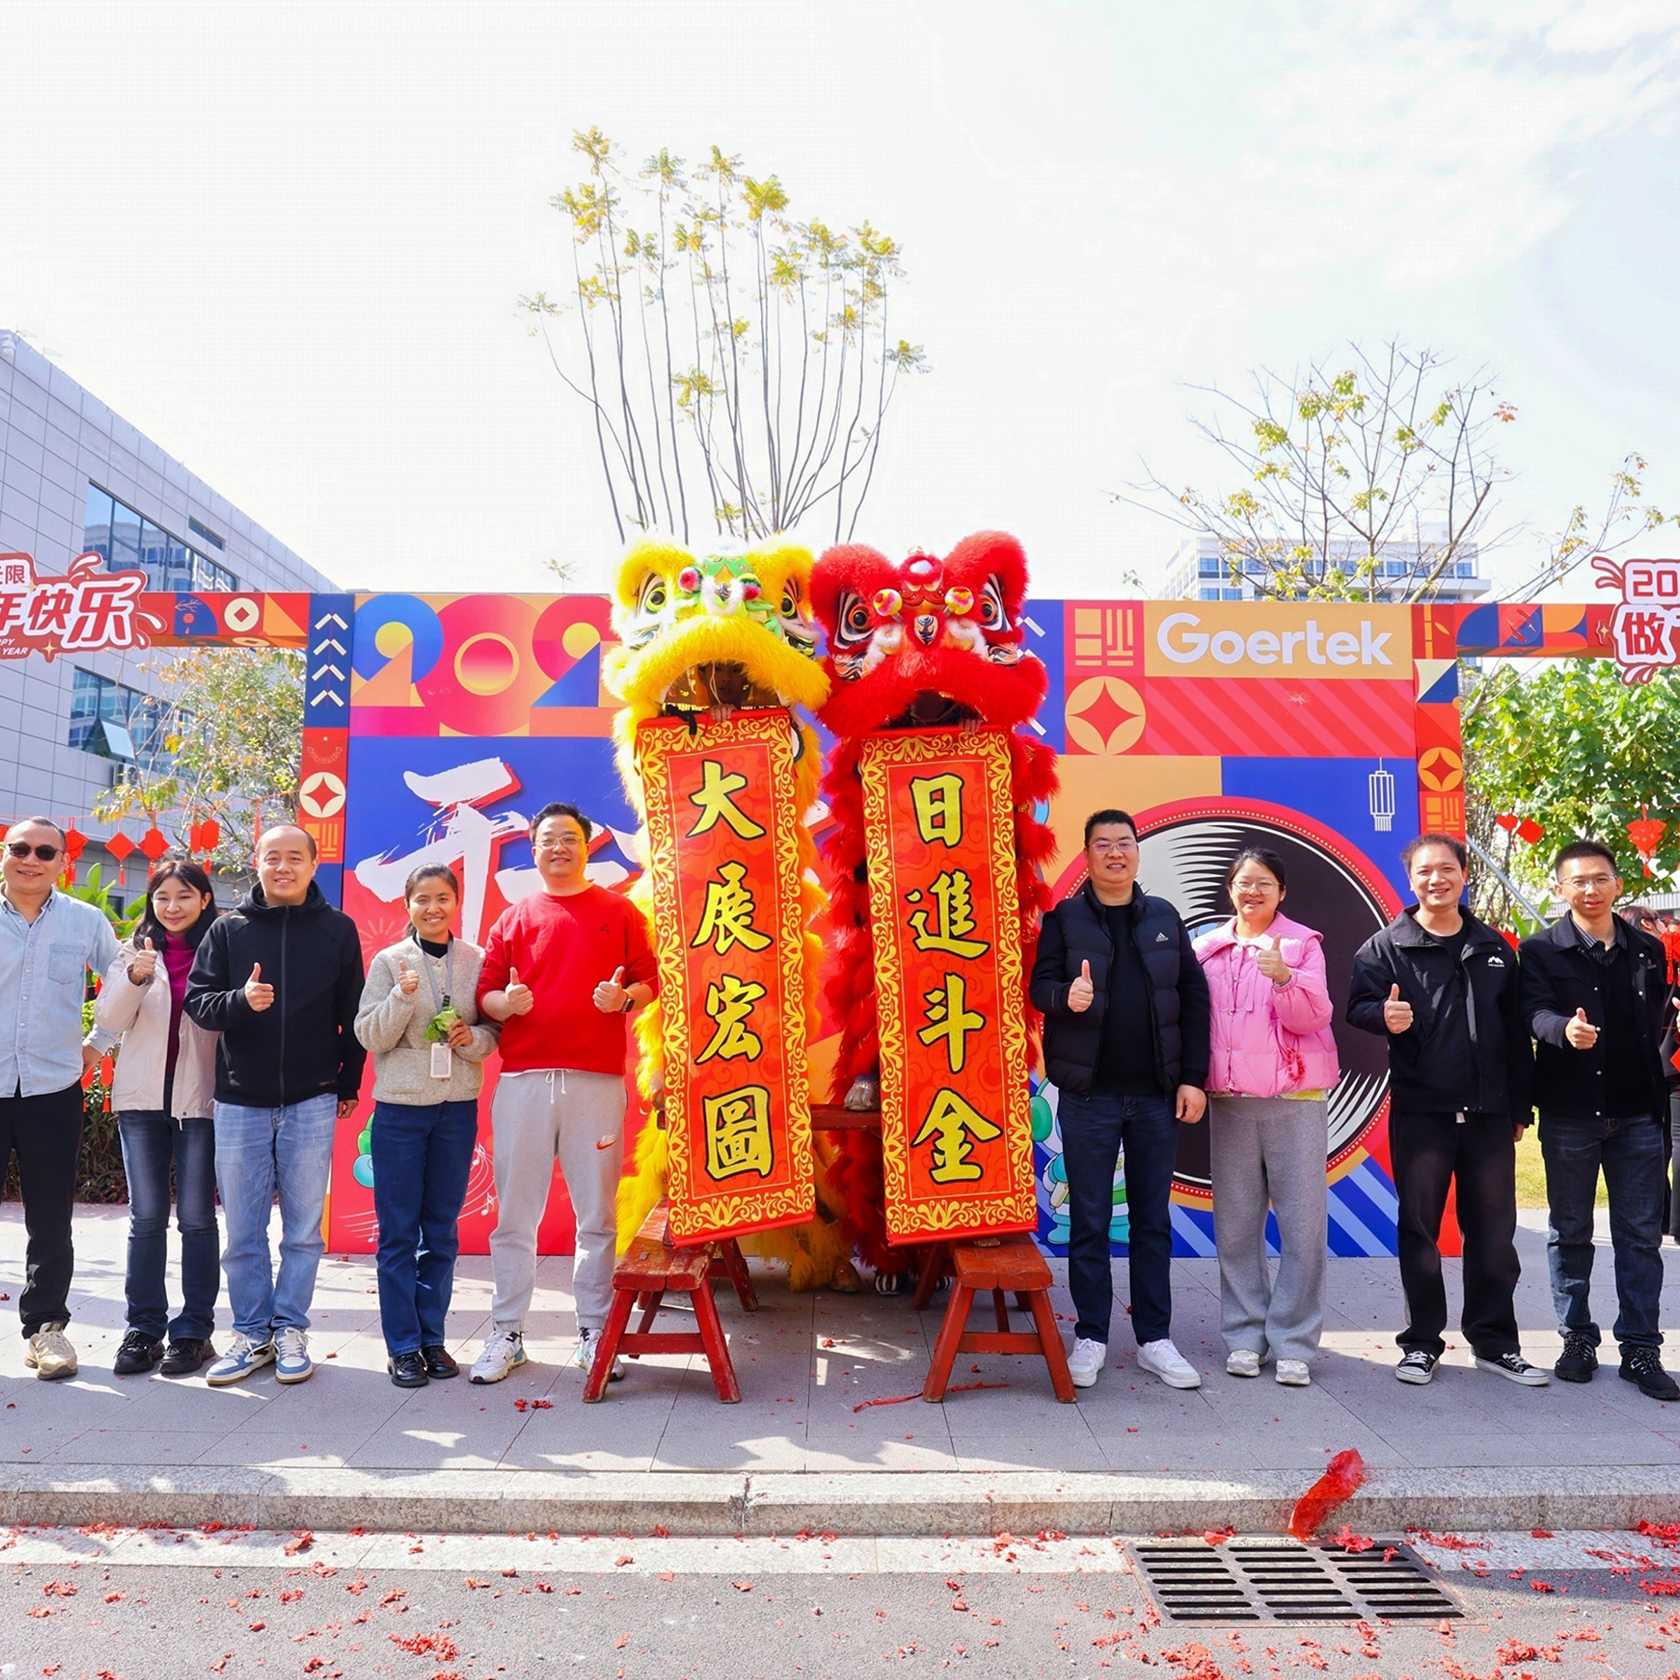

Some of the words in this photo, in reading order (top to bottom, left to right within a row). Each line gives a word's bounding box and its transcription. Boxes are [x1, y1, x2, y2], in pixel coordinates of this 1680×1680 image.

[0, 565, 25, 585] 限
[2, 646, 28, 655] YEAR
[1157, 612, 1394, 665] Goertek
[1621, 611, 1680, 656] 做
[688, 760, 774, 1184] 大展宏圖
[907, 773, 1002, 1184] 日進斗金
